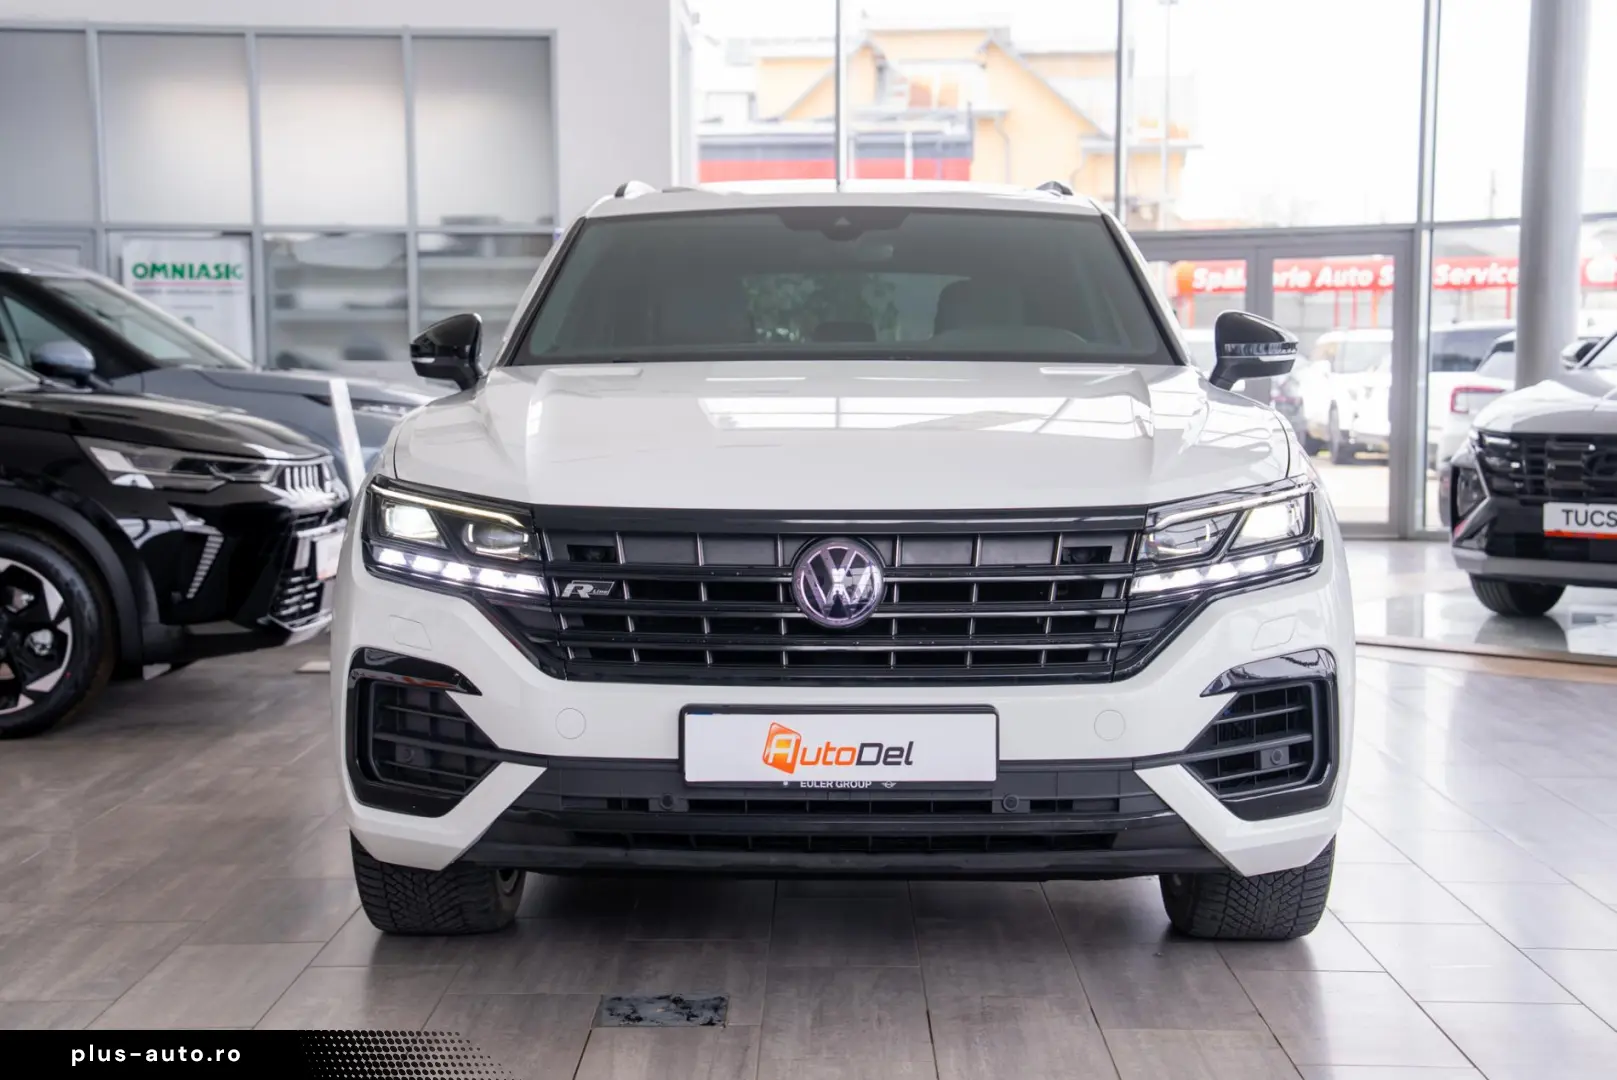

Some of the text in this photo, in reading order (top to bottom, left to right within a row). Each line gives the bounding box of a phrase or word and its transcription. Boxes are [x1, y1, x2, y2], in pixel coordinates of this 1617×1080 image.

[132, 262, 244, 280] OMNIASIG
[1315, 266, 1374, 288] Auto
[561, 583, 594, 598] R
[798, 543, 880, 622] VW
[800, 780, 872, 789] EULER GROUP
